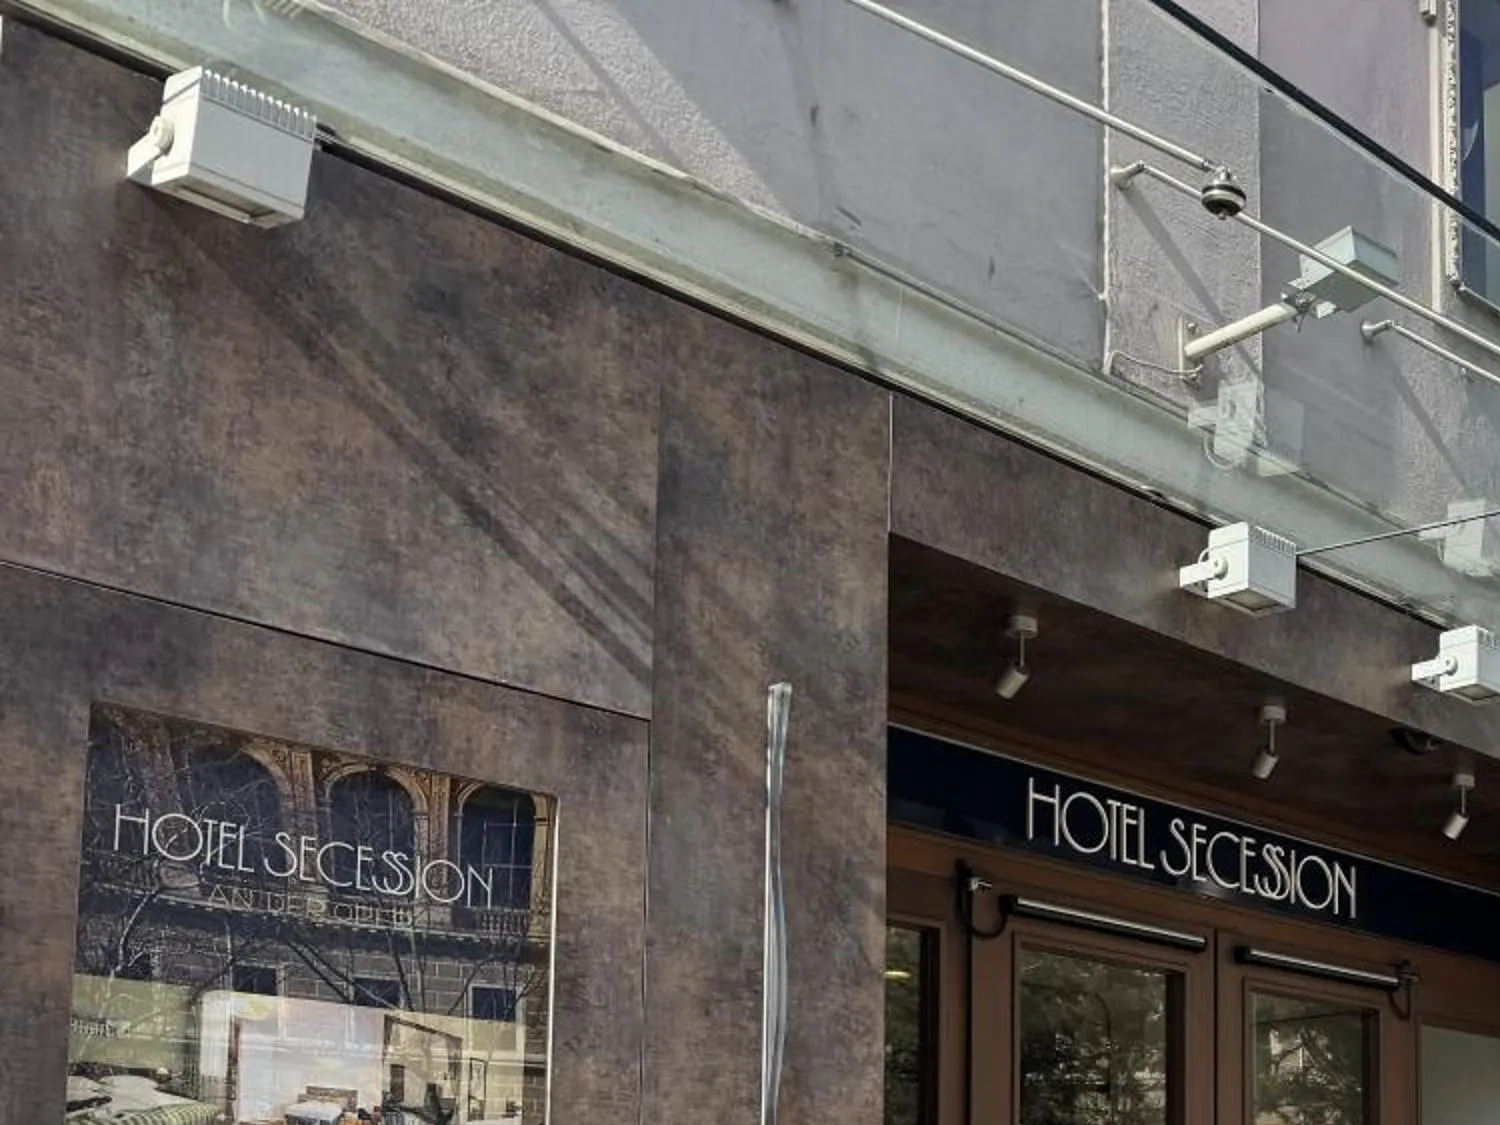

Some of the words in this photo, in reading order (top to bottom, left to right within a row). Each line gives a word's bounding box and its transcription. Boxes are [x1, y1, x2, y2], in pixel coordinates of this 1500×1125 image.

[113, 803, 254, 873] HOTEL
[263, 831, 493, 909] SECESSION
[1027, 777, 1155, 869] HOTEL
[1160, 817, 1356, 919] SECESSION
